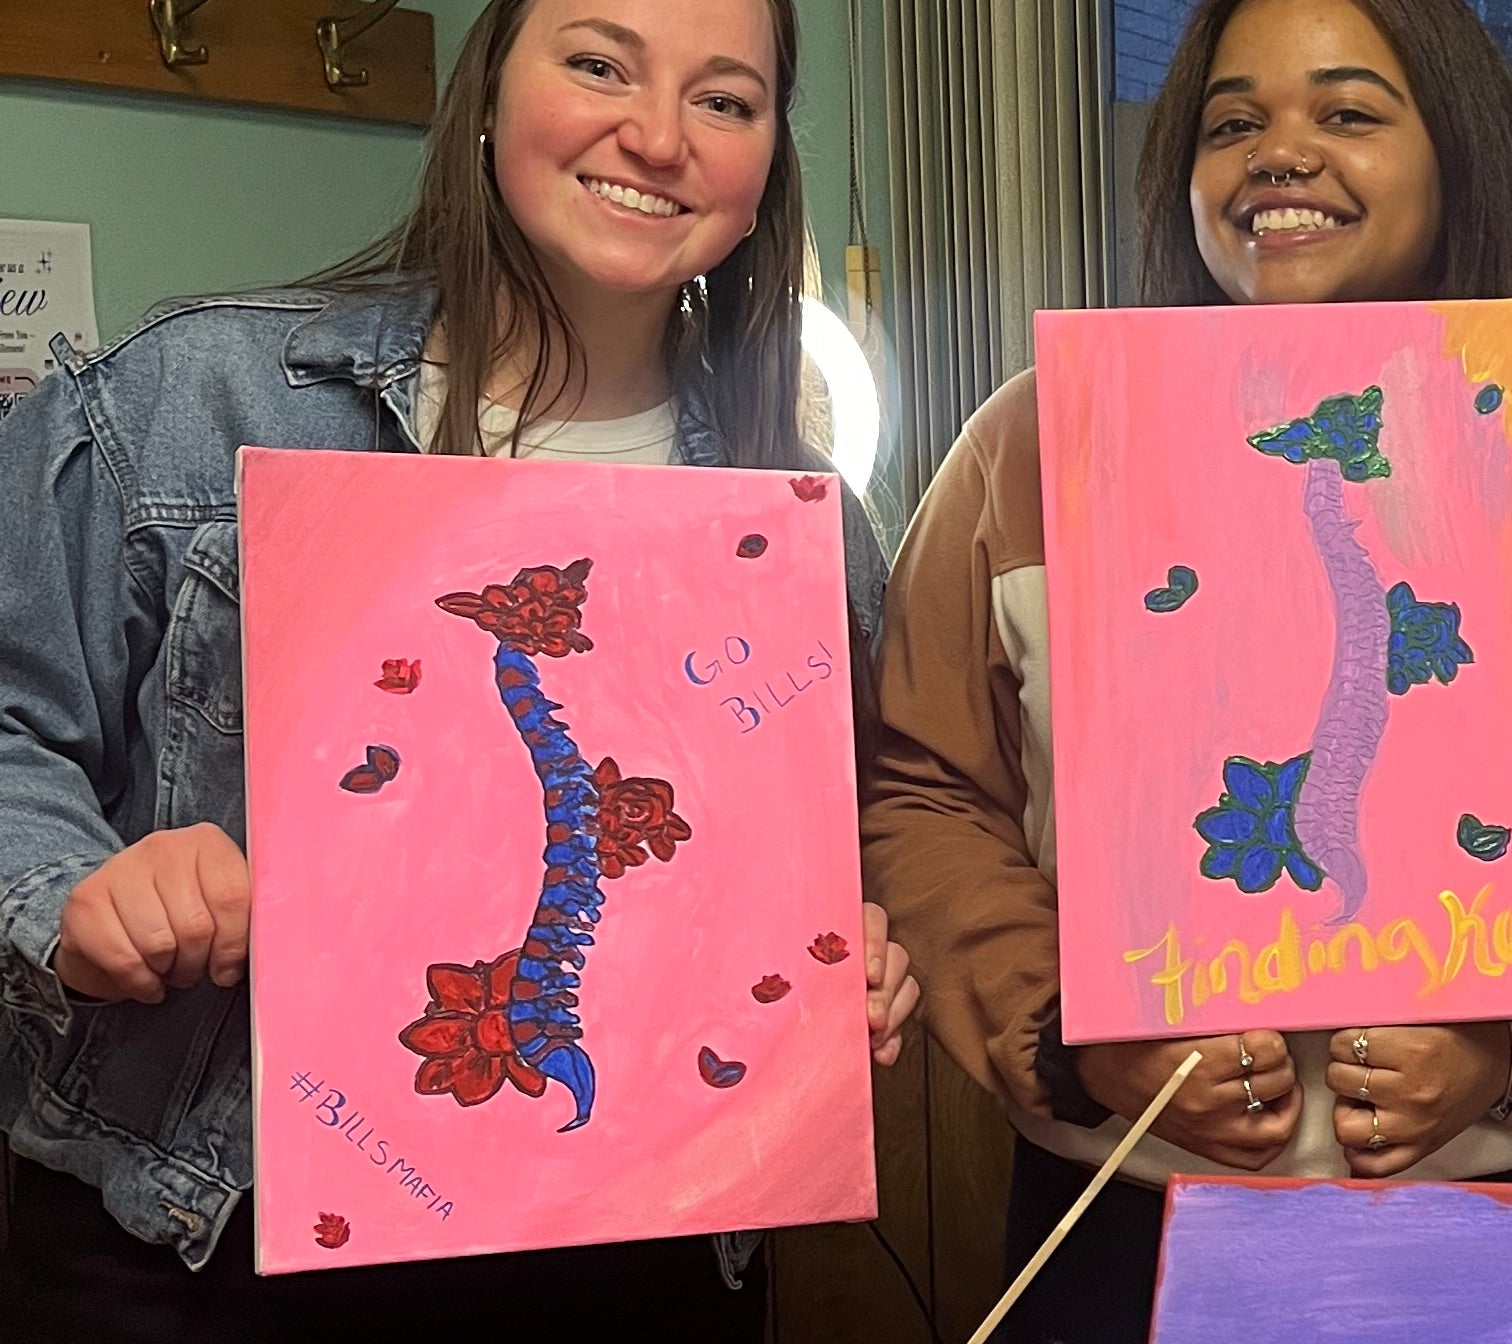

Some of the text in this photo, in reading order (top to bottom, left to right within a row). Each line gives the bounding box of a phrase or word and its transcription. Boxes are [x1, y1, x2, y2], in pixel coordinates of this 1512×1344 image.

[0, 276, 49, 316] ew
[684, 636, 750, 685] GO
[720, 640, 834, 733] BILLS!
